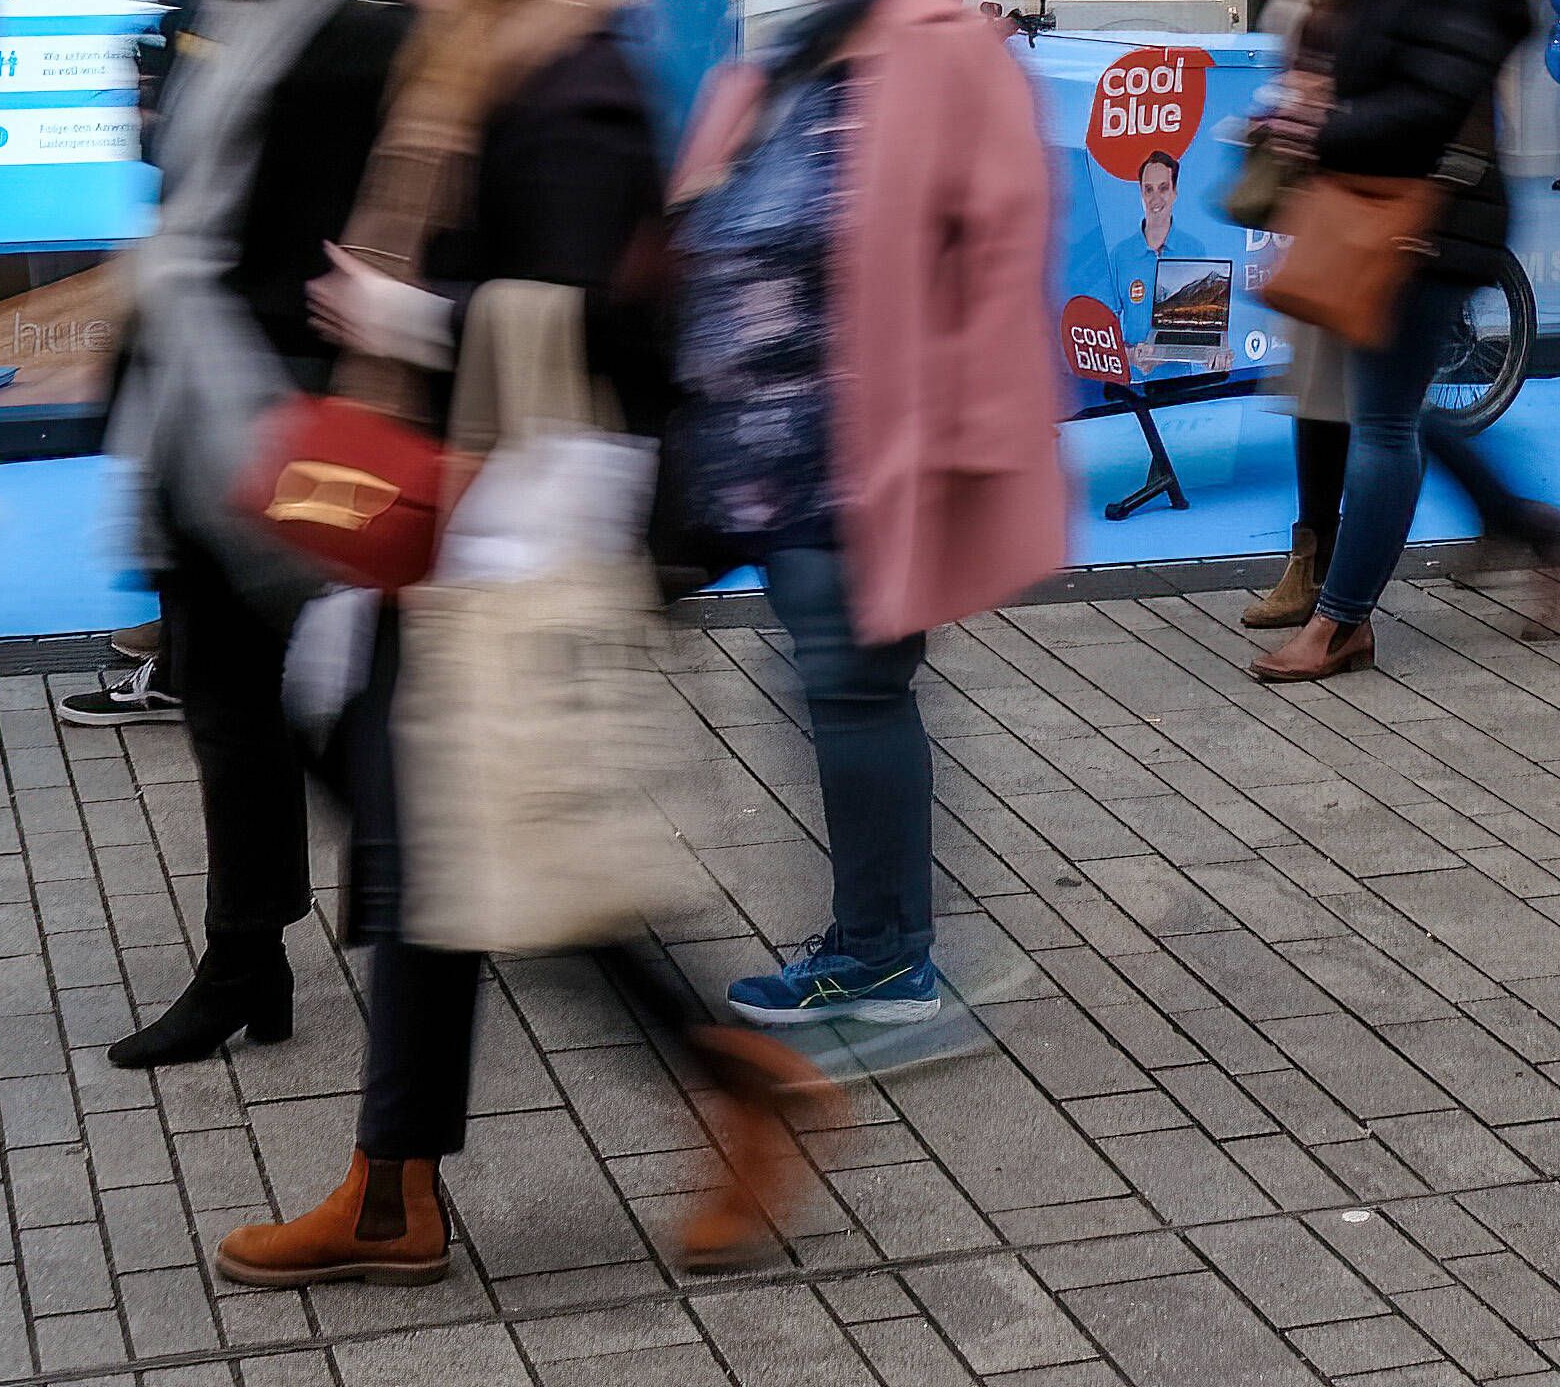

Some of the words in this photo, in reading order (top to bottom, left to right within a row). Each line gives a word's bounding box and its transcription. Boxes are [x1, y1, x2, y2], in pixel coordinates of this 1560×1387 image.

[1100, 56, 1184, 98] cool
[1100, 99, 1182, 139] blue
[1071, 324, 1116, 350] cool
[1075, 346, 1124, 374] blue
